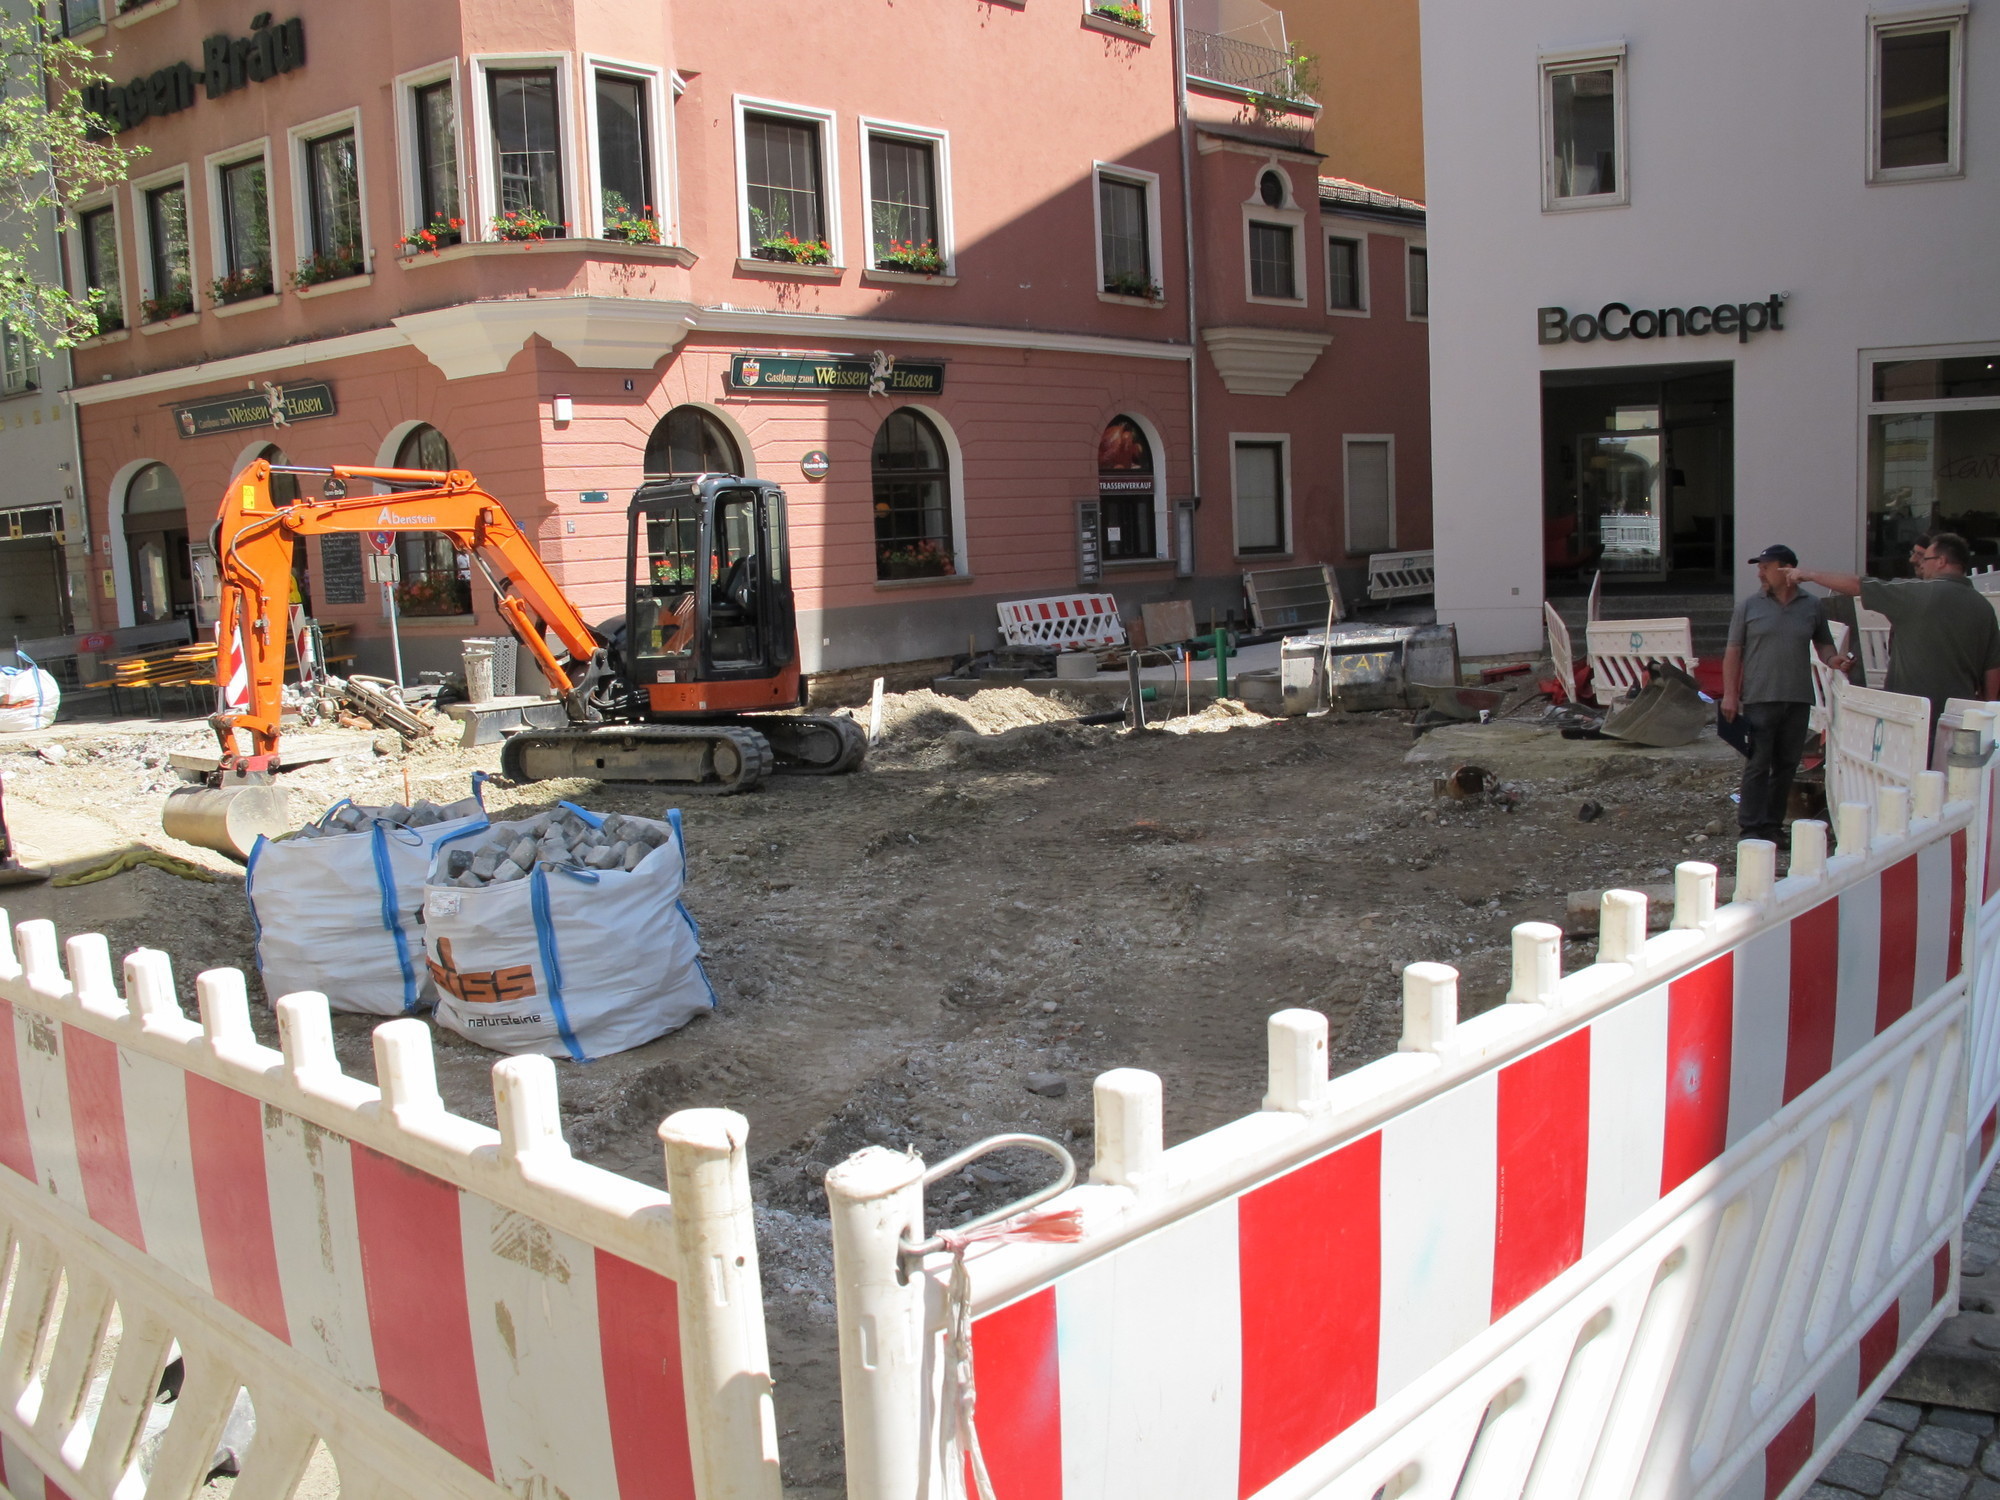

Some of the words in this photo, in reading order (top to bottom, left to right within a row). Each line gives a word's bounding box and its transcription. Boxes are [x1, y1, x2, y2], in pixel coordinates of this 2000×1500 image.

[81, 11, 305, 142] Hasen-Bräu
[1537, 293, 1784, 346] BoConcept
[626, 379, 633, 391] 4
[815, 365, 868, 386] Weissen
[892, 370, 933, 388] Hasen
[226, 402, 271, 424] Weissen
[286, 397, 324, 416] Hasen
[1099, 482, 1152, 490] TRASSENVERKAUF
[378, 506, 436, 525] Abenstein
[1341, 653, 1388, 673] CAT
[468, 1014, 541, 1028] natursteine
